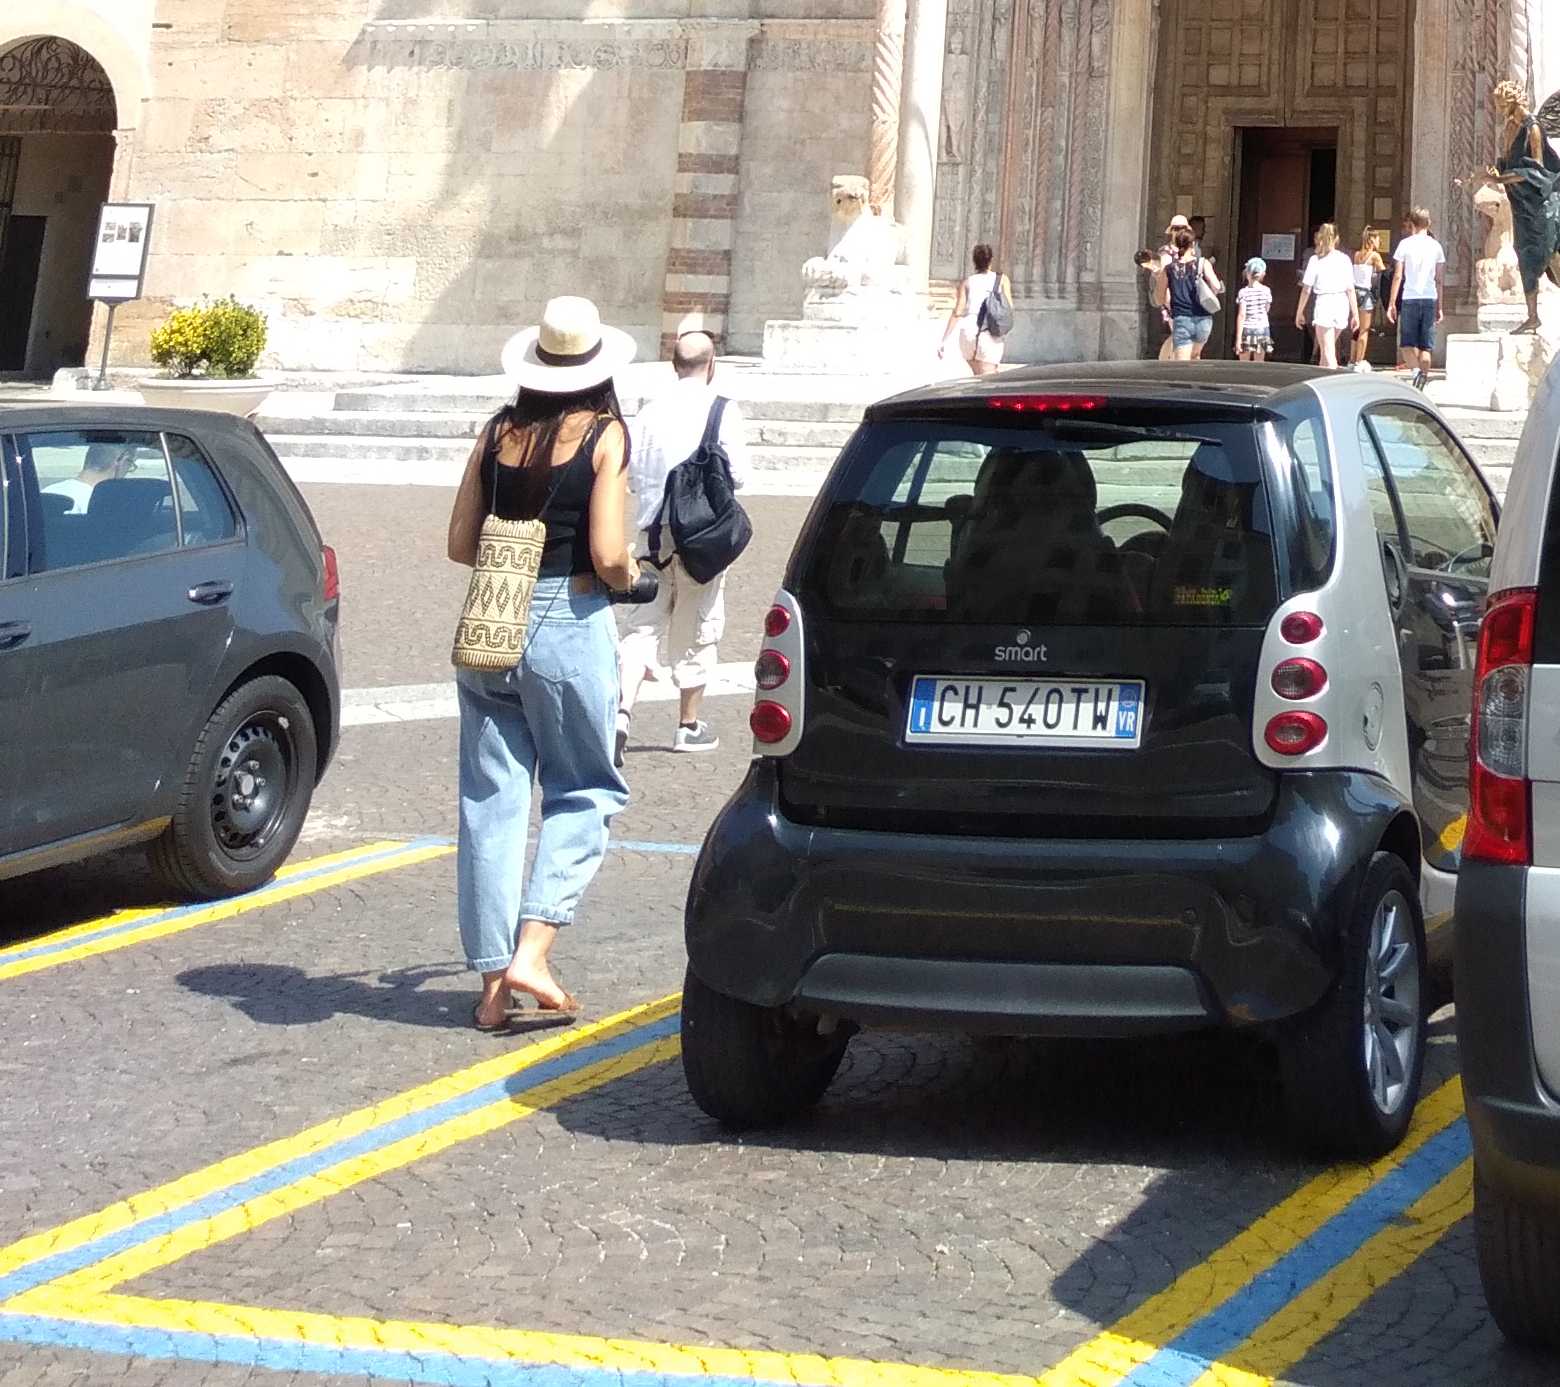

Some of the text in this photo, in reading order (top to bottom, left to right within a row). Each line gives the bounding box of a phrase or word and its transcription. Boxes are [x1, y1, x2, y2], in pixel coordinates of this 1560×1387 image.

[994, 644, 1048, 662] smart
[937, 683, 984, 729] CH
[995, 686, 1113, 732] 540TW
[1117, 710, 1136, 733] VR
